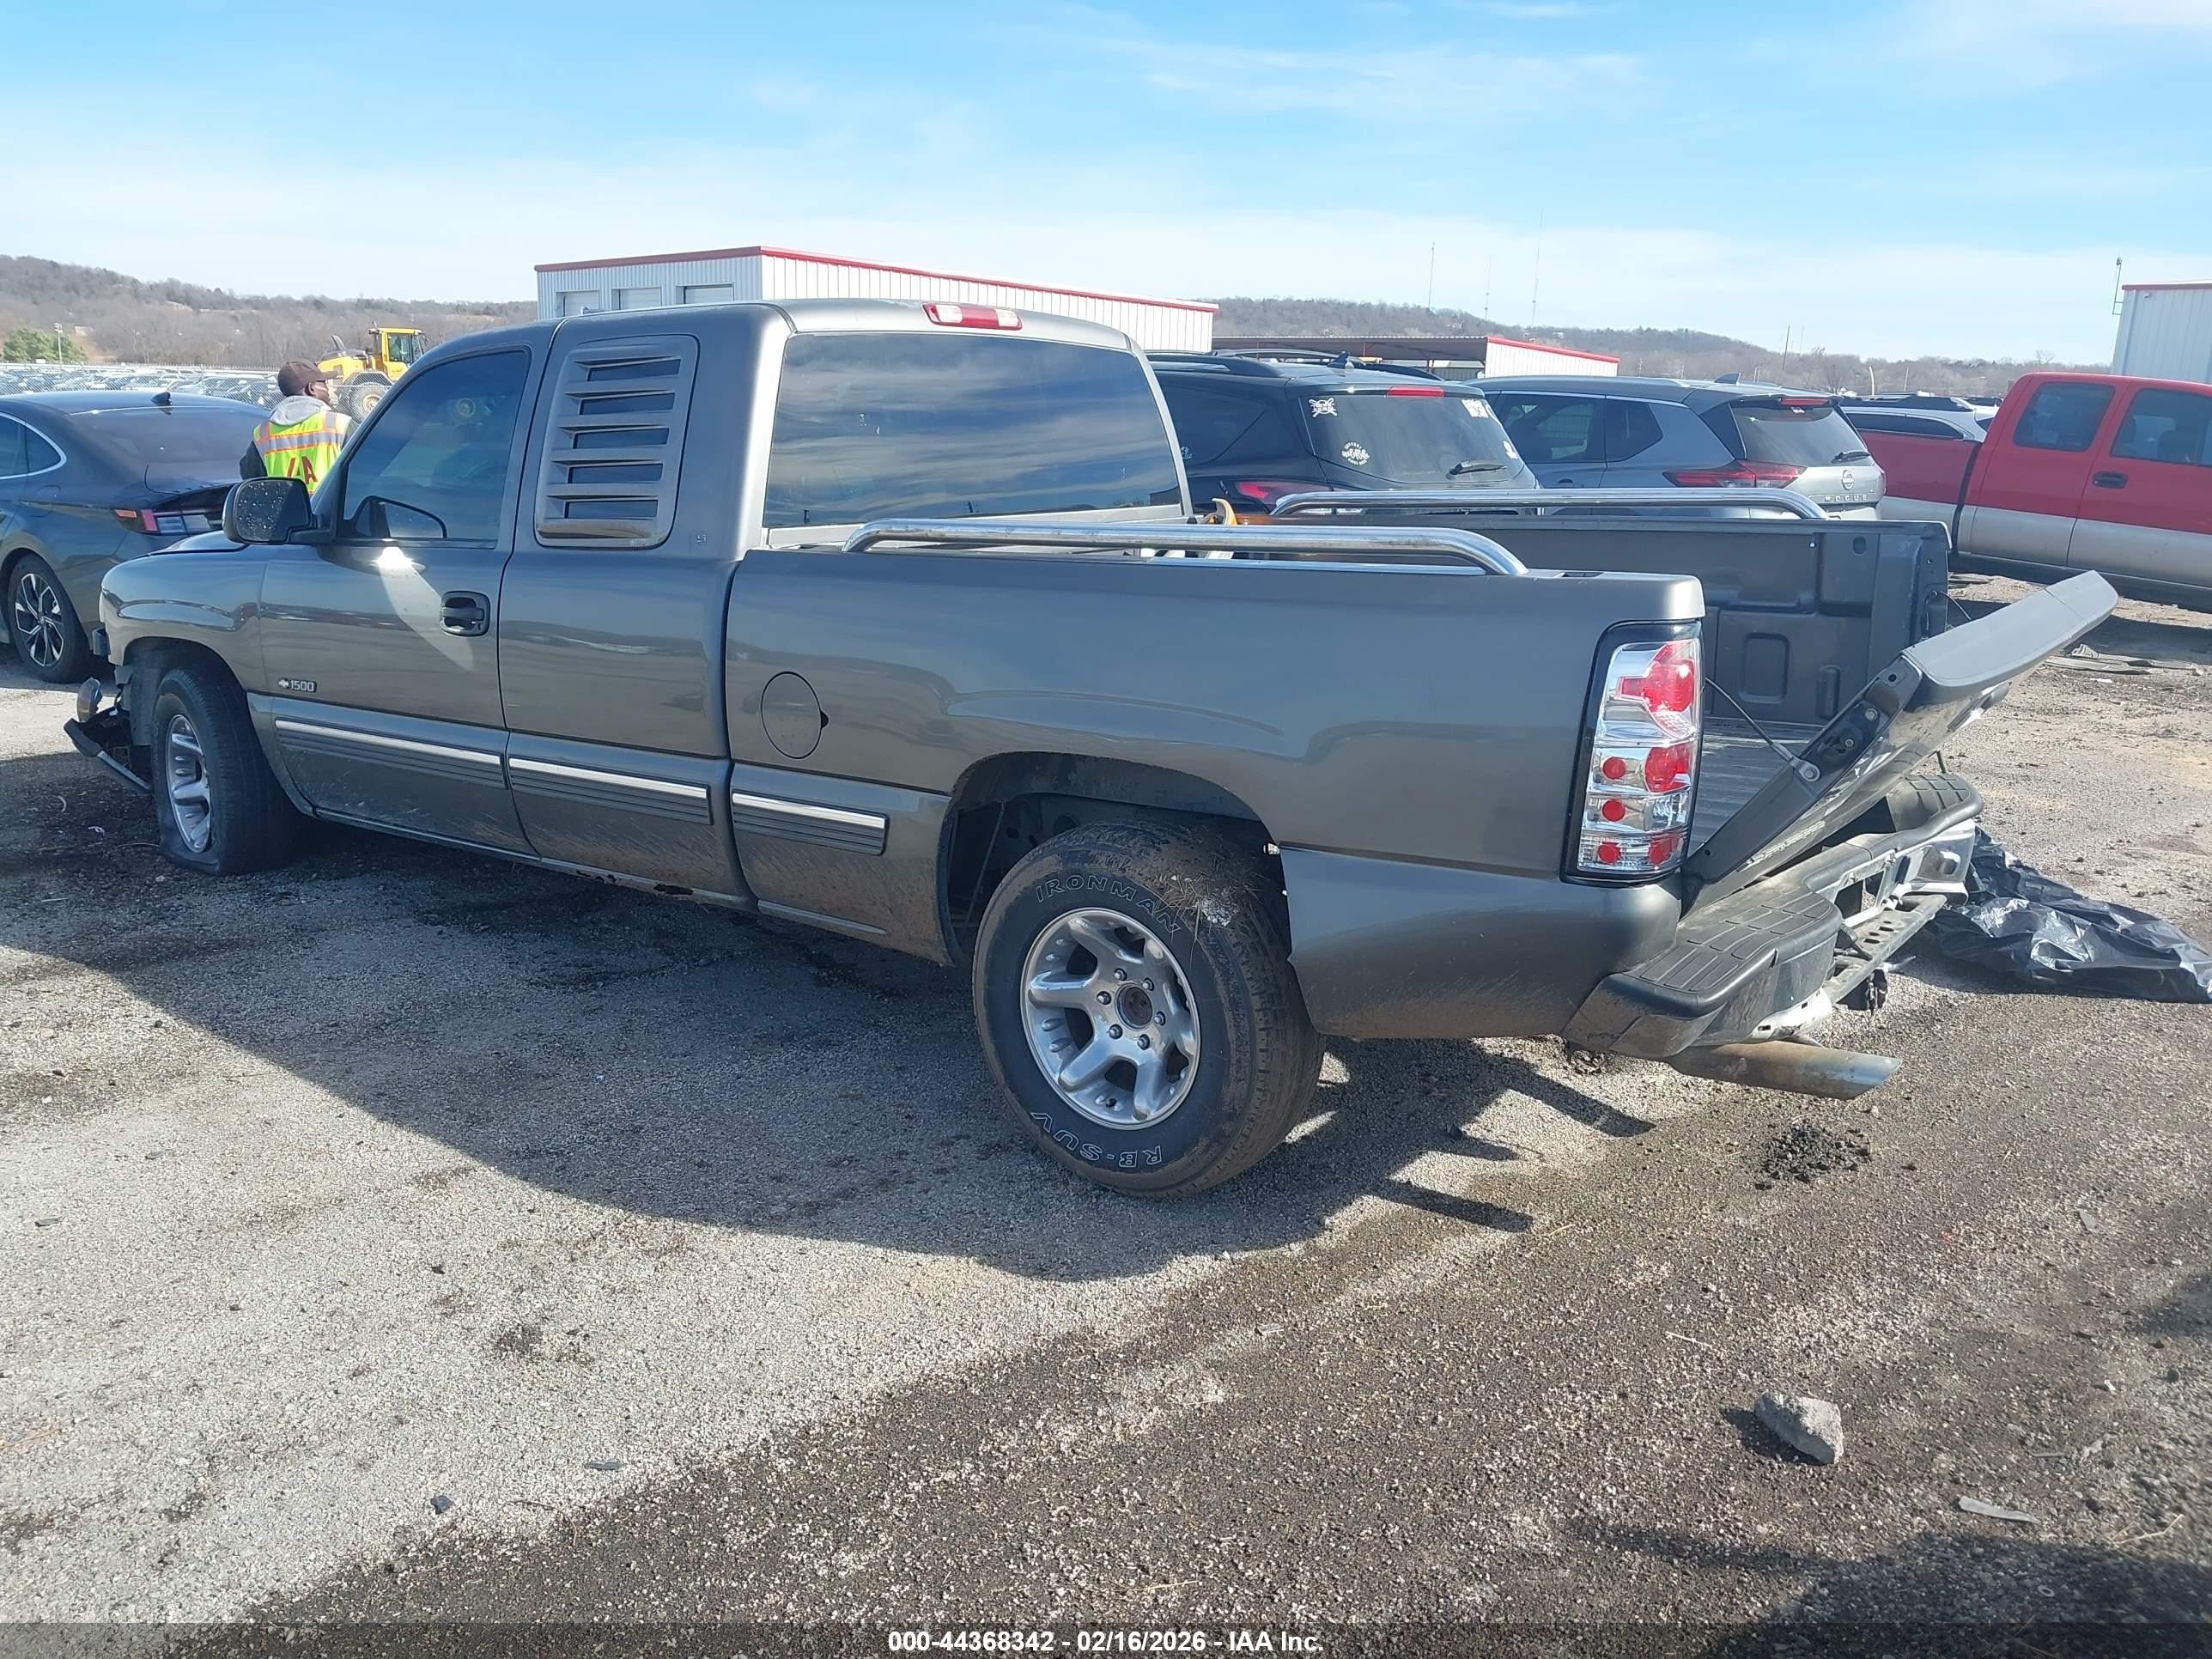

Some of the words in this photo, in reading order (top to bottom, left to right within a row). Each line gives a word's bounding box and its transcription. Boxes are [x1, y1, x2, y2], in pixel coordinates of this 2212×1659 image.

[289, 679, 314, 692] 1500
[1036, 874, 1182, 933] IRONMAN
[1030, 1112, 1163, 1168] RB-SUV
